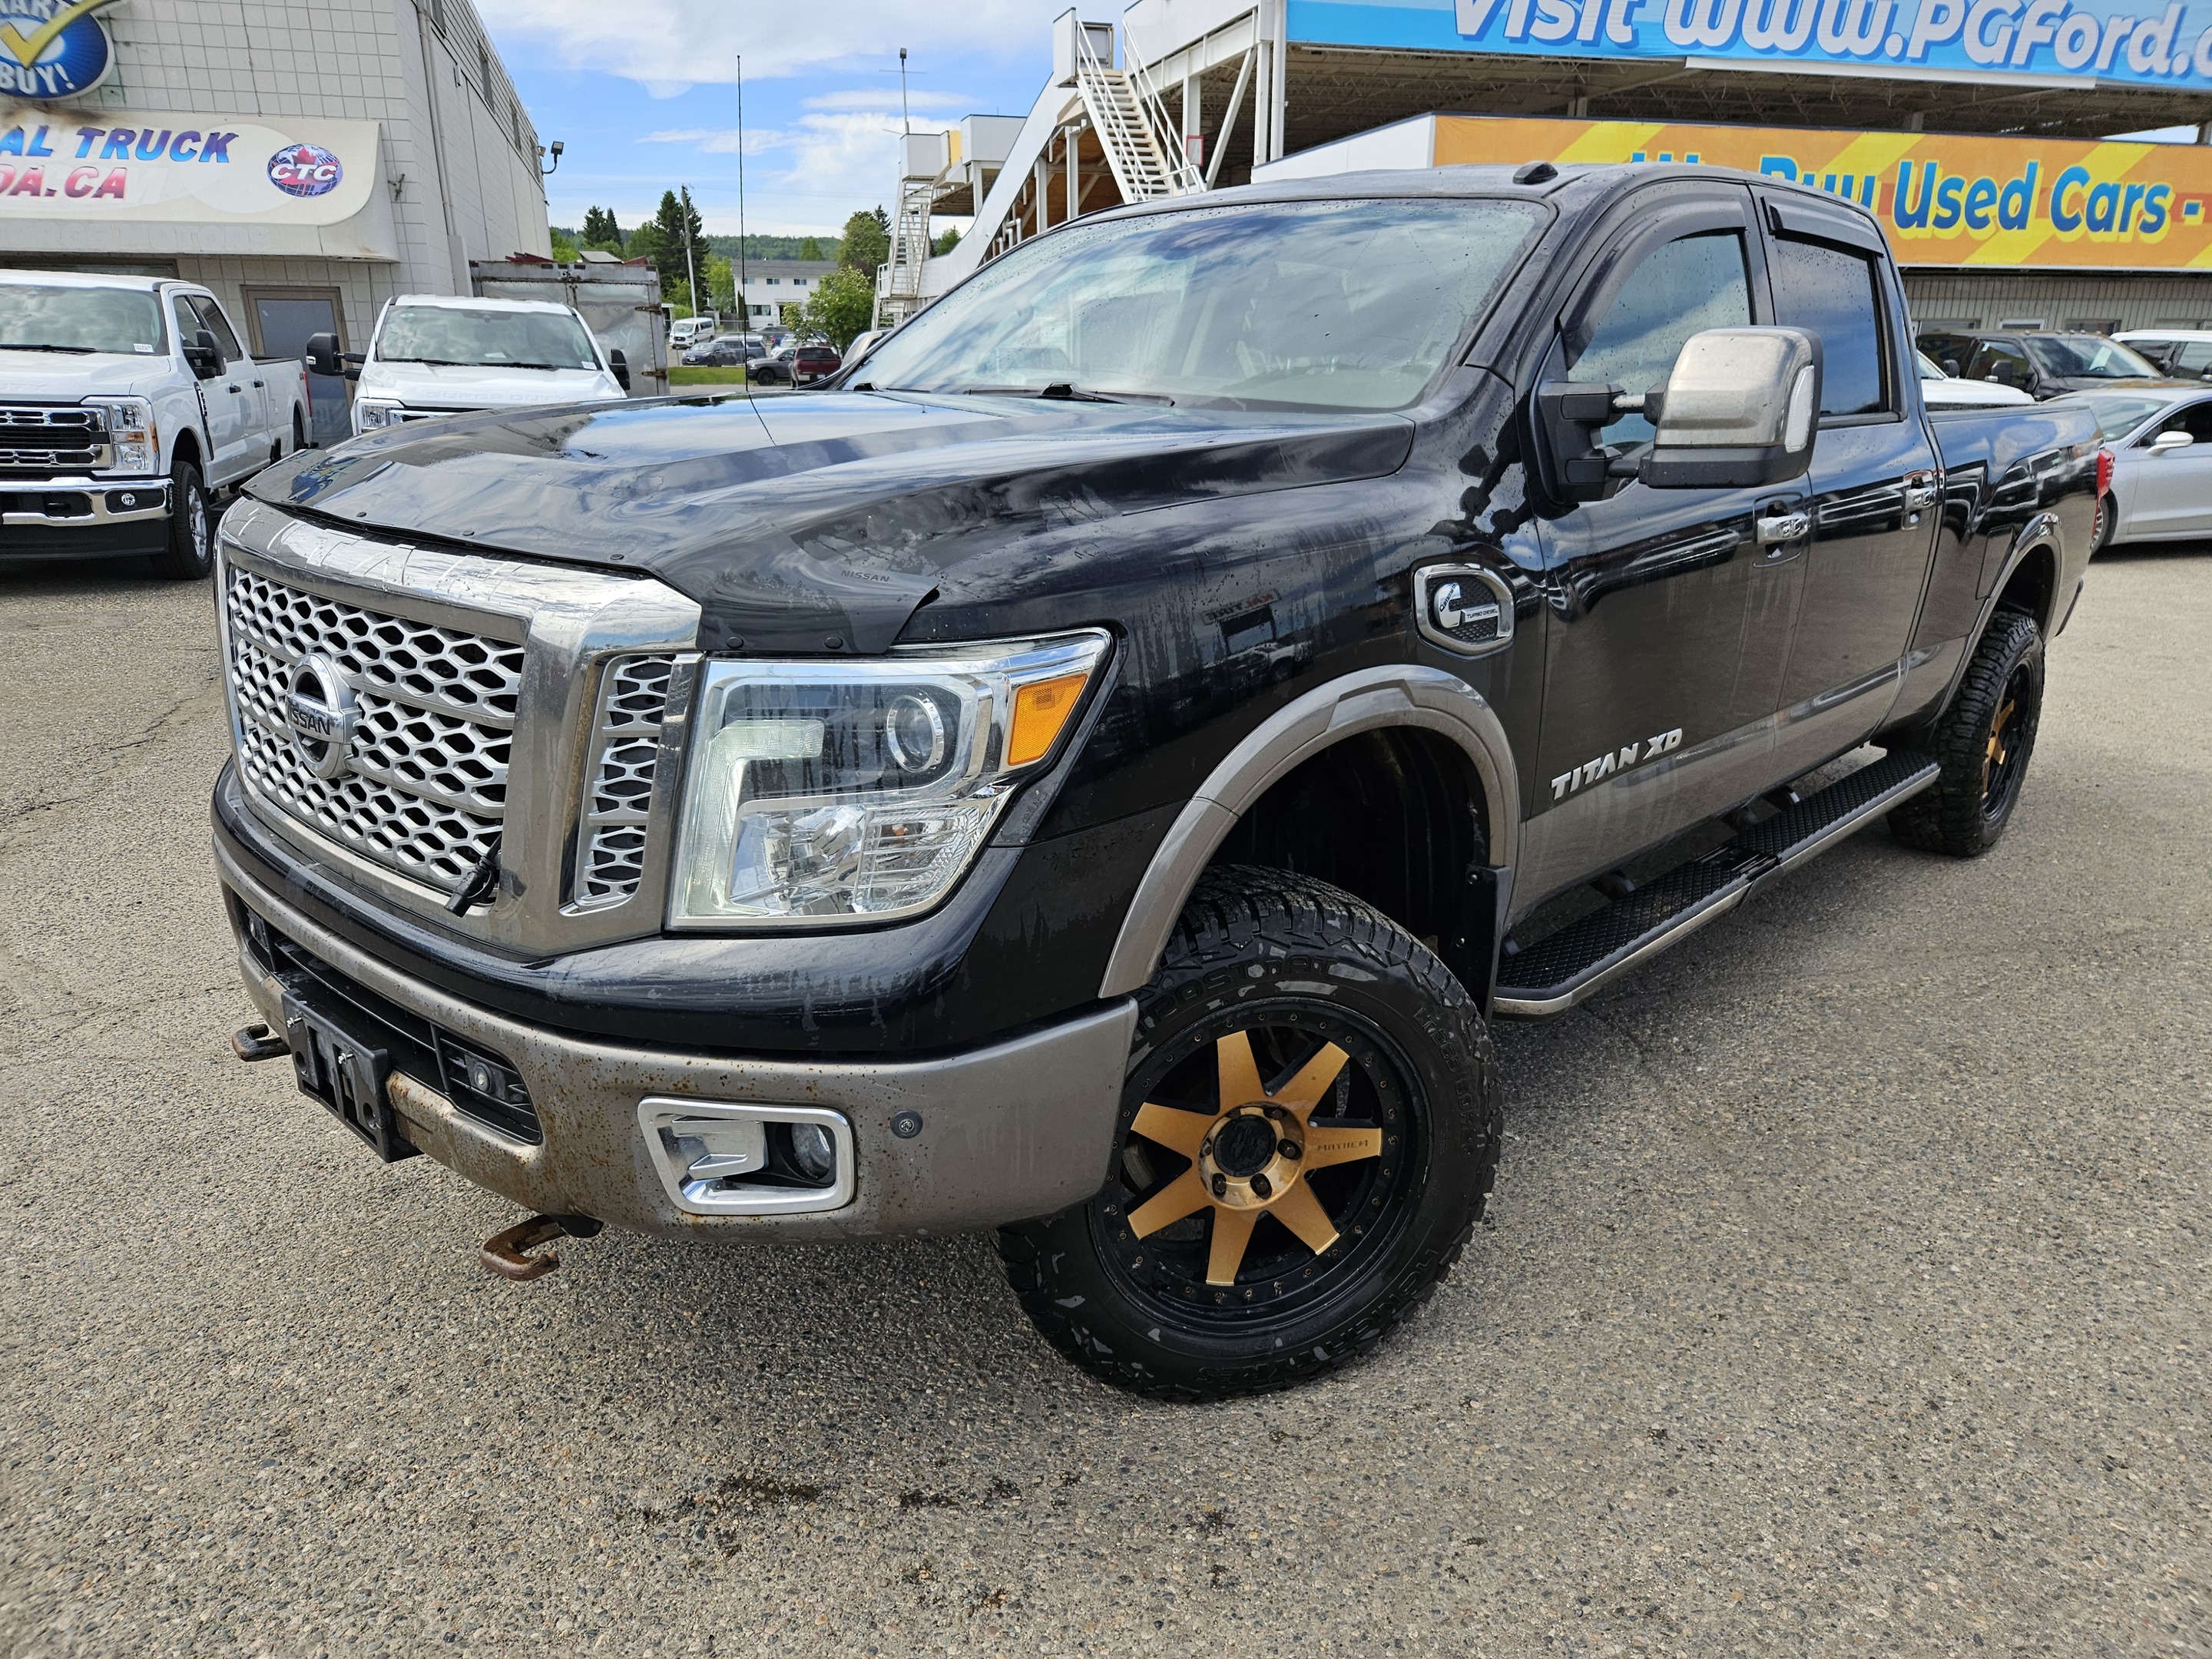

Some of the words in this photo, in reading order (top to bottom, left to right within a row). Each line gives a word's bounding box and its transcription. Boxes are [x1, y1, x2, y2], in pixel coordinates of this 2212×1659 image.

[0, 61, 75, 95] BUY!
[75, 127, 239, 163] TRUCK
[271, 163, 336, 181] CTC
[1893, 161, 2039, 231] Used
[2050, 165, 2171, 233] Cars
[841, 570, 890, 582] NISSAN
[1551, 742, 1639, 800] TITAN
[1643, 727, 1683, 760] XD
